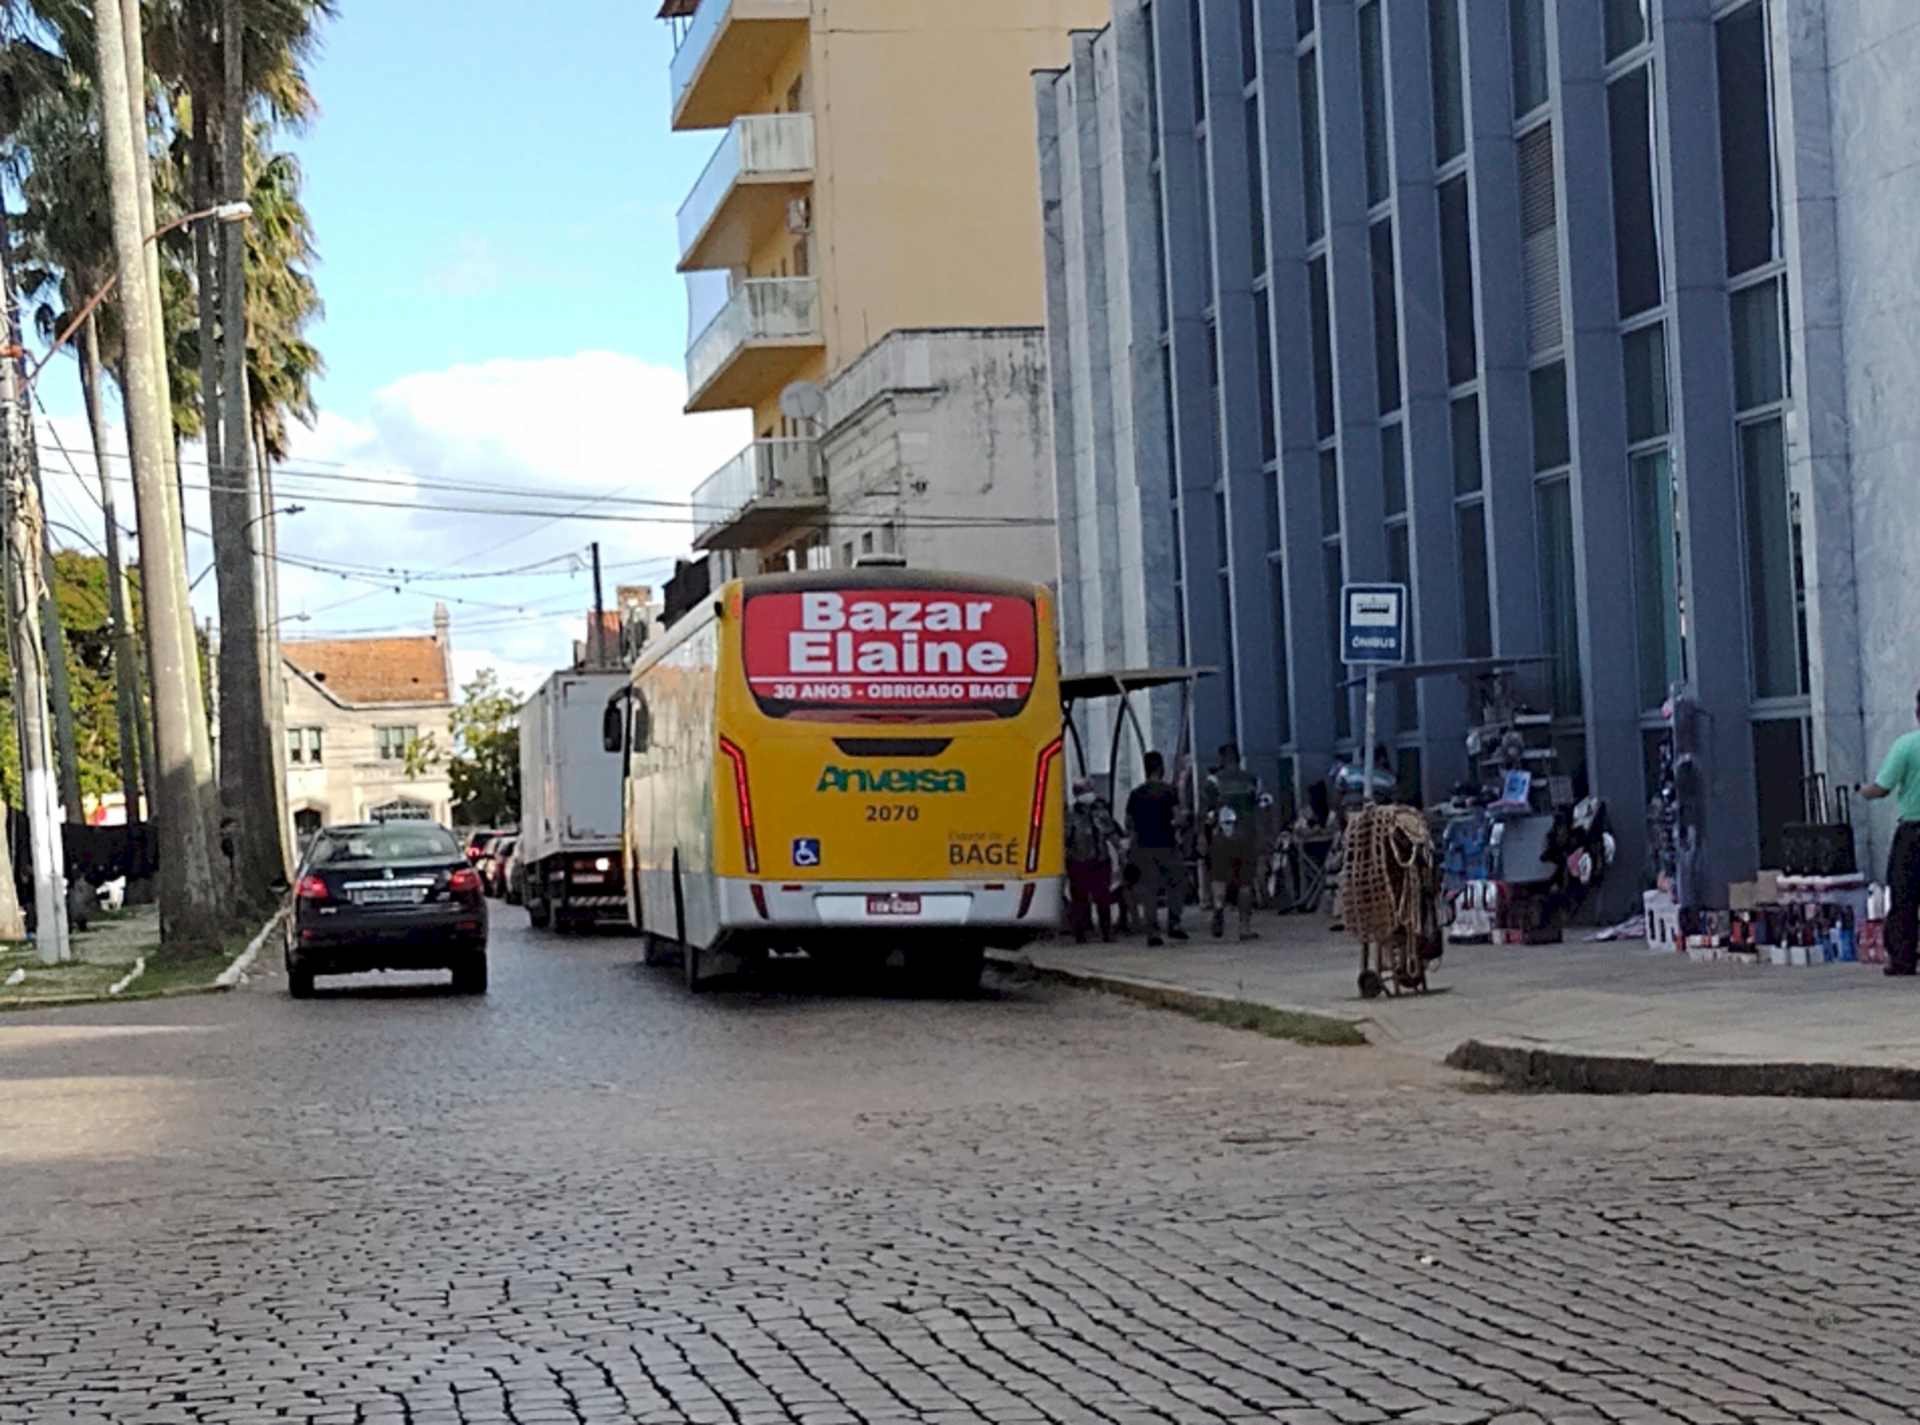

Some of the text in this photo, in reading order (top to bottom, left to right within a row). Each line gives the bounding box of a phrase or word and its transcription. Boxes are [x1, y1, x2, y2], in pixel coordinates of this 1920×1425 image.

[802, 591, 993, 631] Bazar
[788, 632, 1008, 674] Elaine
[801, 684, 852, 698] ANOS
[867, 684, 964, 698] OBRIGADO
[816, 765, 967, 793] Anversa
[865, 805, 919, 822] 2070
[949, 837, 1019, 865] BAGÉ
